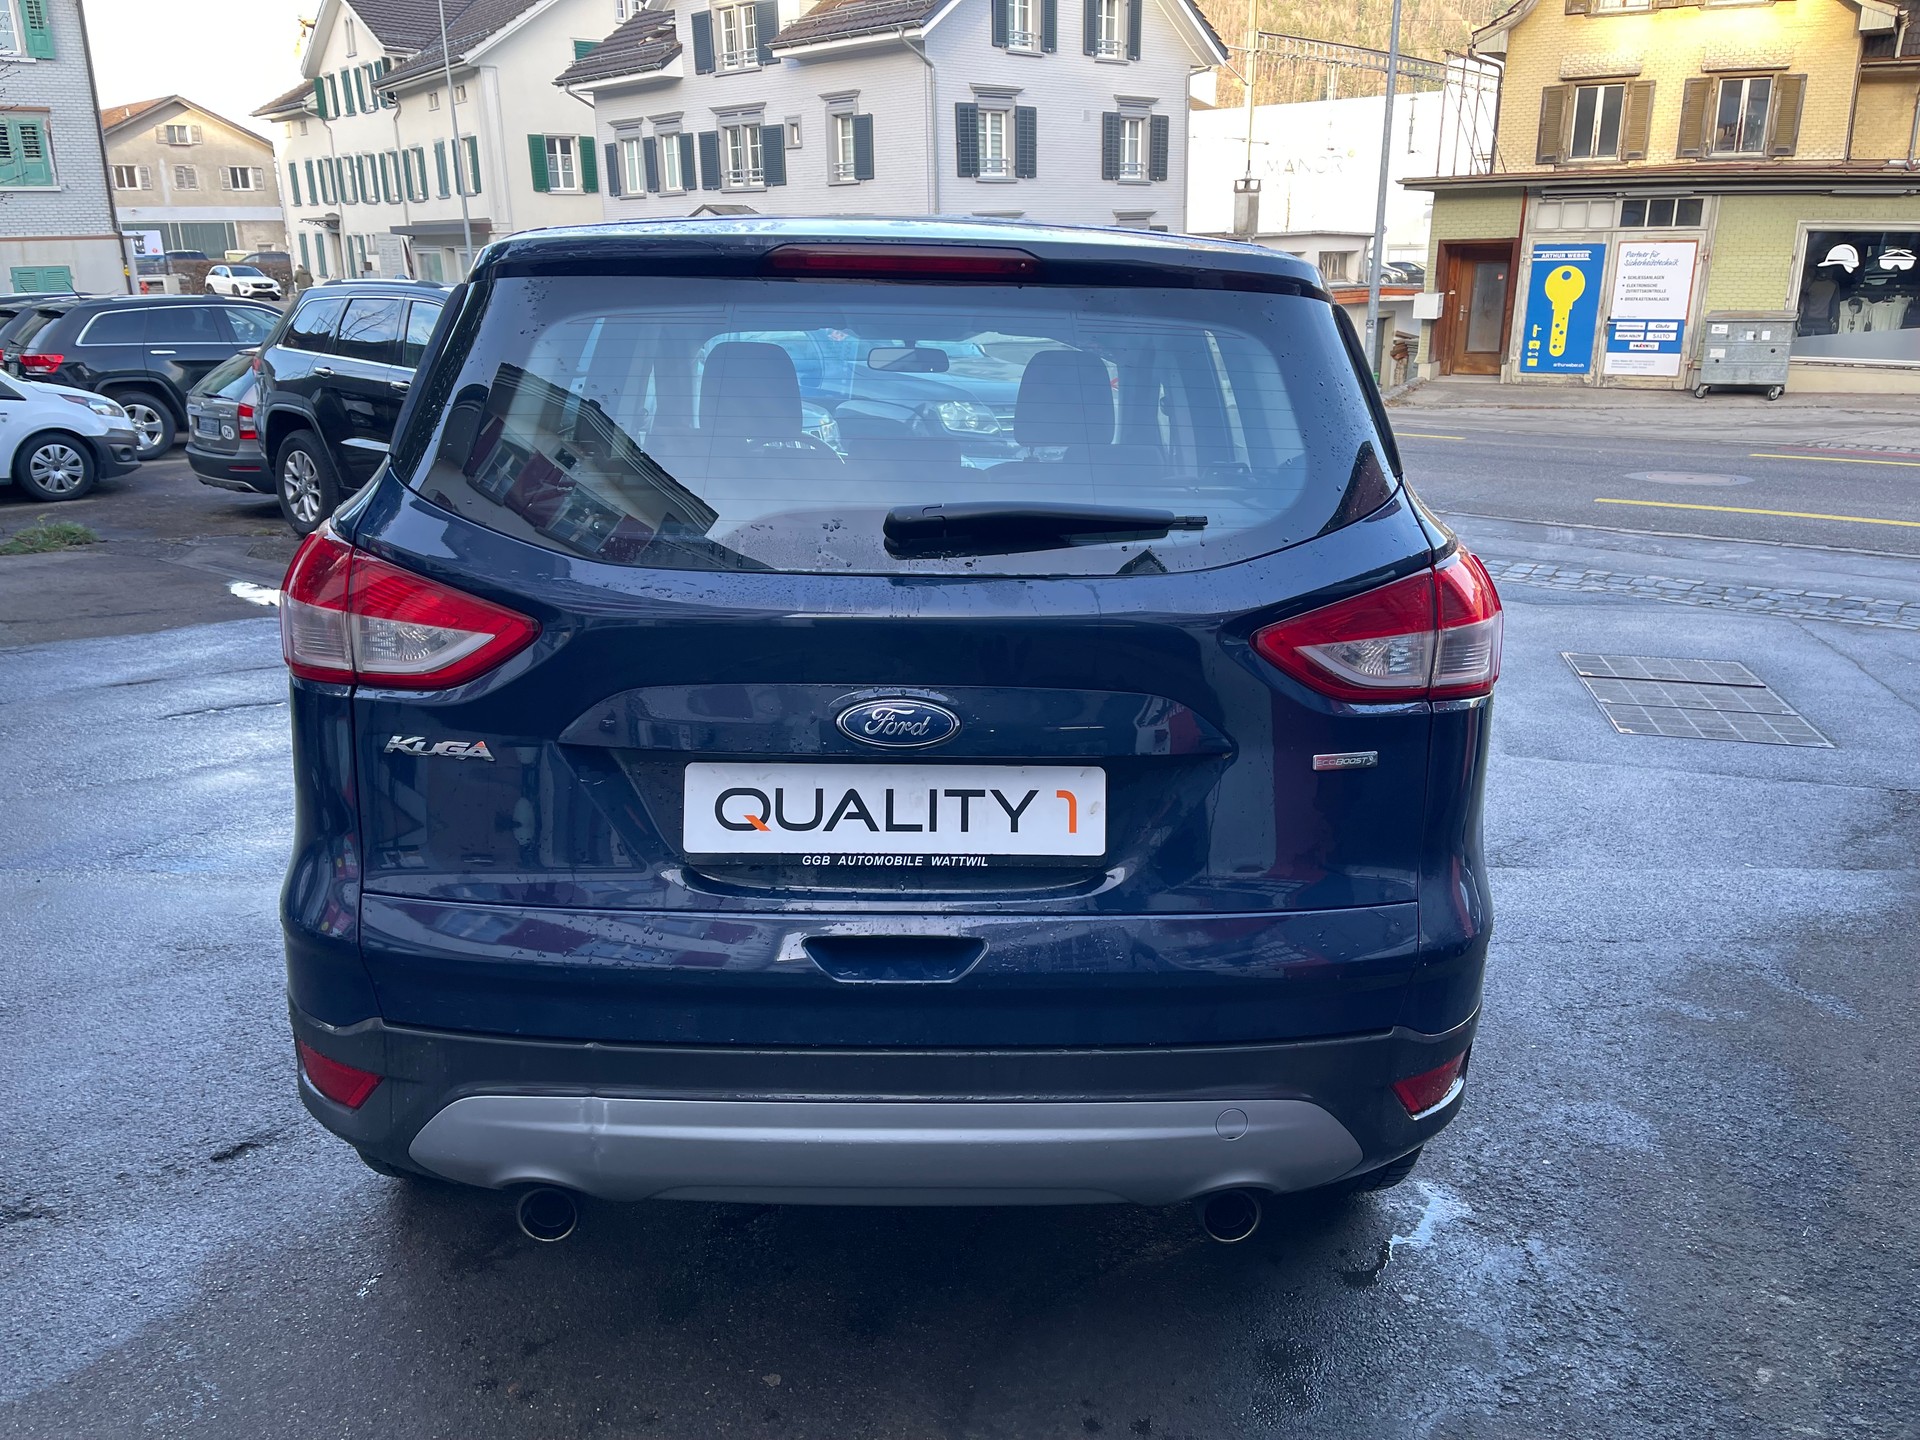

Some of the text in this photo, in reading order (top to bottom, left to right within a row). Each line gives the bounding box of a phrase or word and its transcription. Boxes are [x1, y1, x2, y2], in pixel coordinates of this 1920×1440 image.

[1625, 250, 1661, 259] Partner für
[223, 427, 233, 437] CH
[864, 707, 932, 737] Ford
[383, 735, 496, 762] KUGA
[714, 787, 1040, 833] QUALITY
[801, 855, 990, 868] GGB AUTOMOBILE WATTWIL
